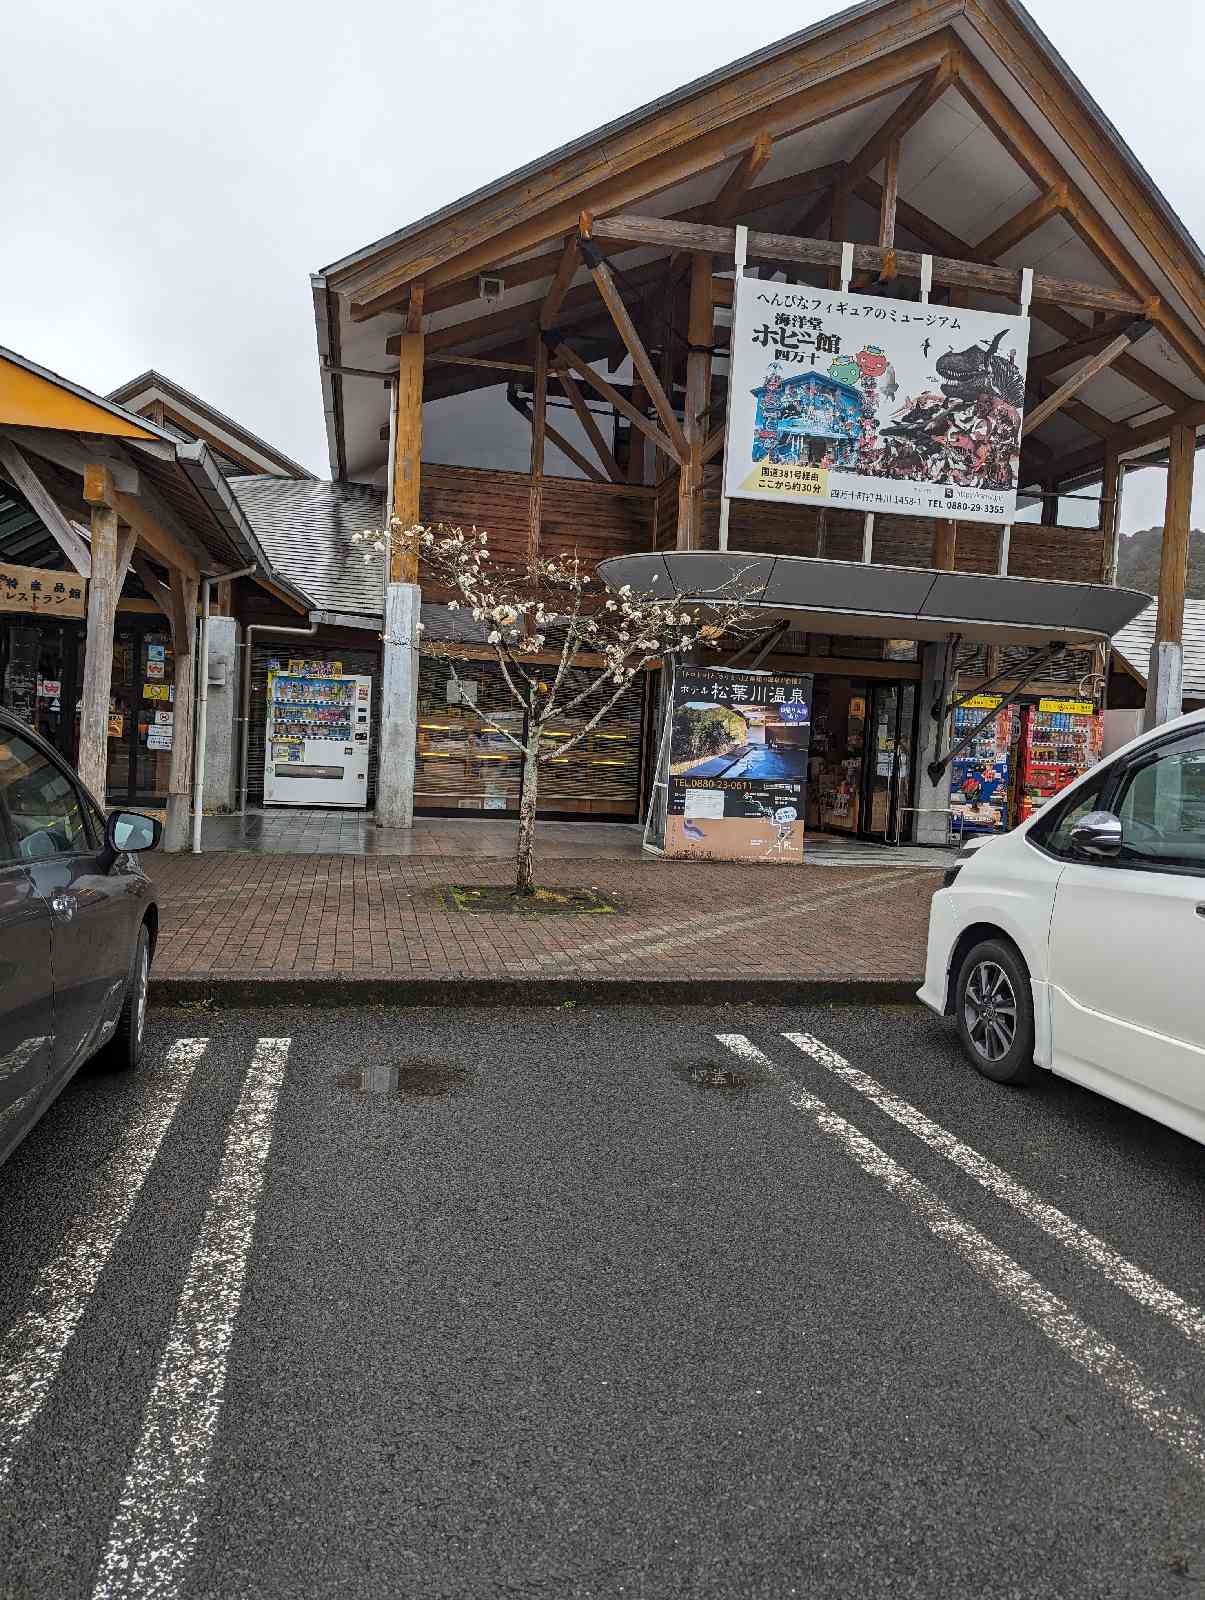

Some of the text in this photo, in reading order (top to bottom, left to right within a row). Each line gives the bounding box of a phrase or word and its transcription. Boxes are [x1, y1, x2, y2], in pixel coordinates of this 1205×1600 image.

[757, 293, 962, 330] へんぴなフィギュアのミュージアム
[774, 312, 824, 332] 海洋堂
[752, 323, 842, 355] ホビー館
[774, 349, 821, 366] 四万十
[761, 466, 819, 482] 国道381号経由
[758, 479, 822, 494] ここから約30分
[928, 499, 944, 509] TEL
[6, 592, 68, 604] レストラン
[710, 682, 806, 705] 松葉川温泉
